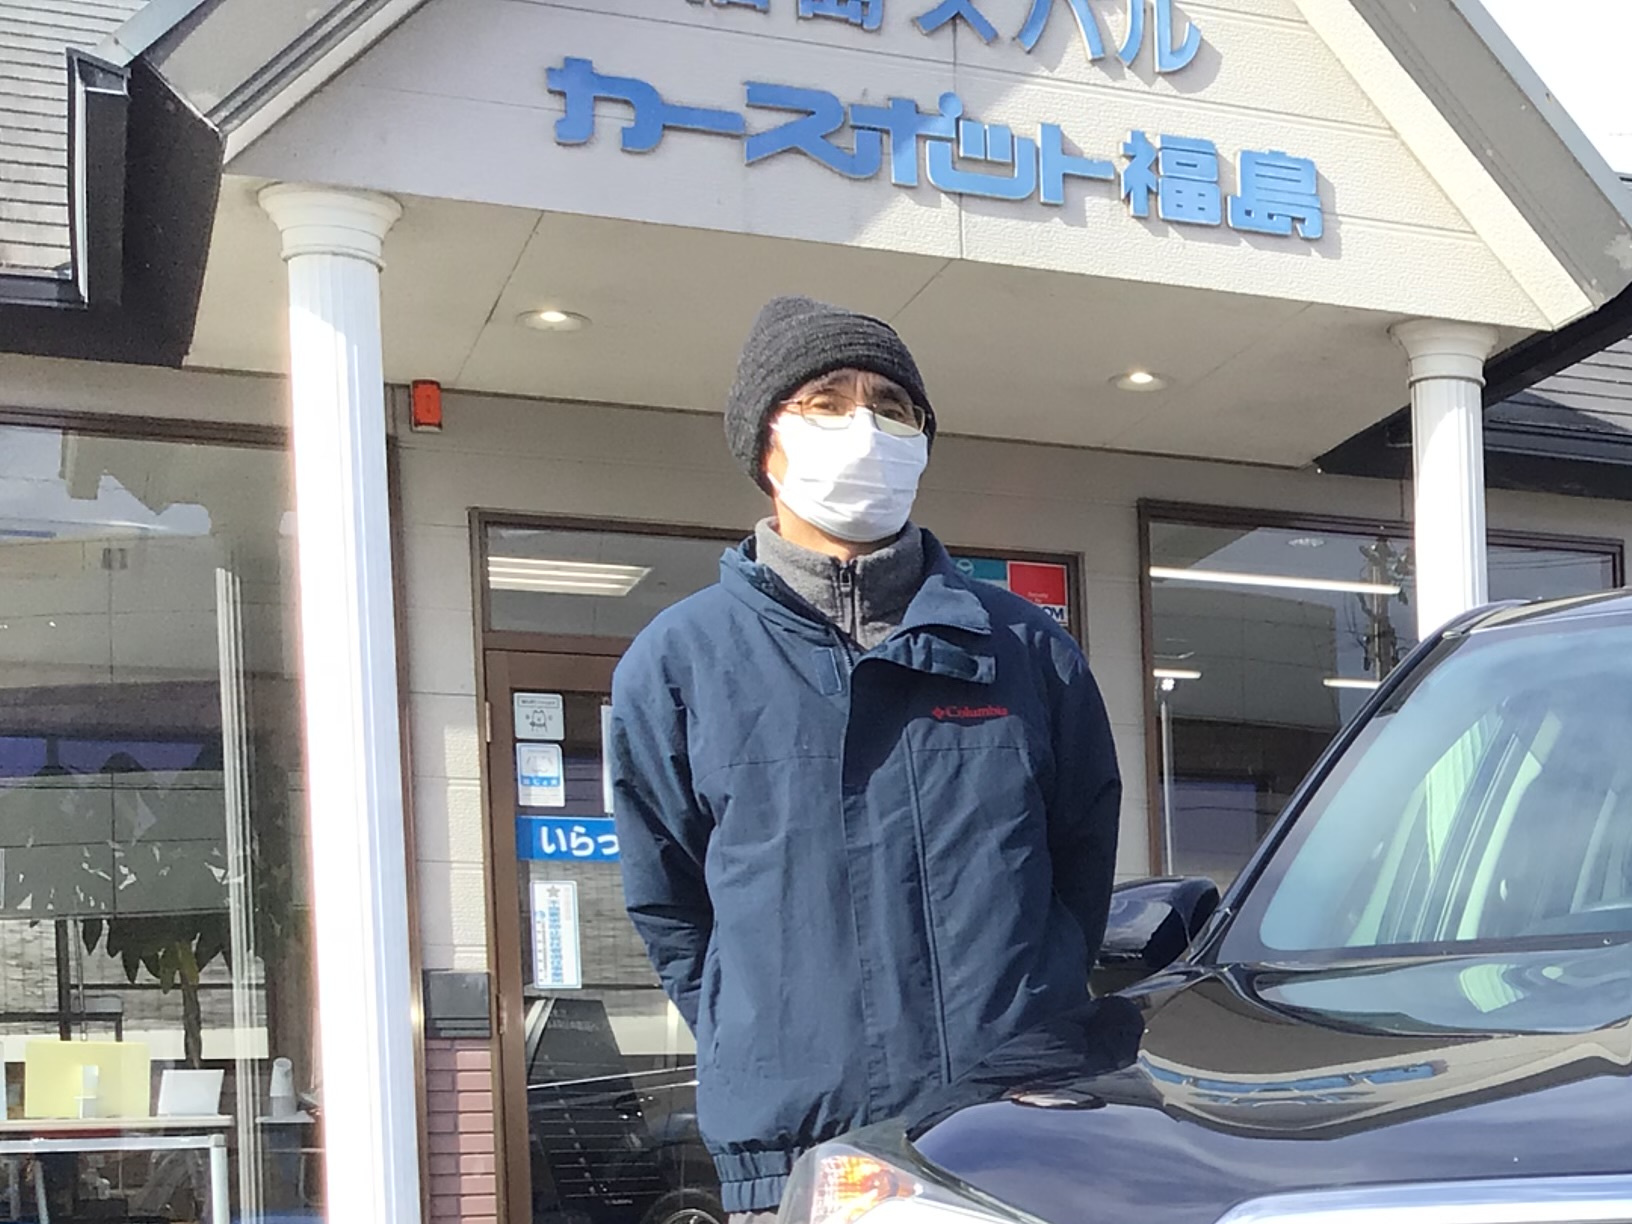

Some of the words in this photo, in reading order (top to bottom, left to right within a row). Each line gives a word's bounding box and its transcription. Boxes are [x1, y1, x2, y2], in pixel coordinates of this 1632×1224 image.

[546, 55, 1324, 240] カースポット福島
[945, 705, 1009, 719] Columbia
